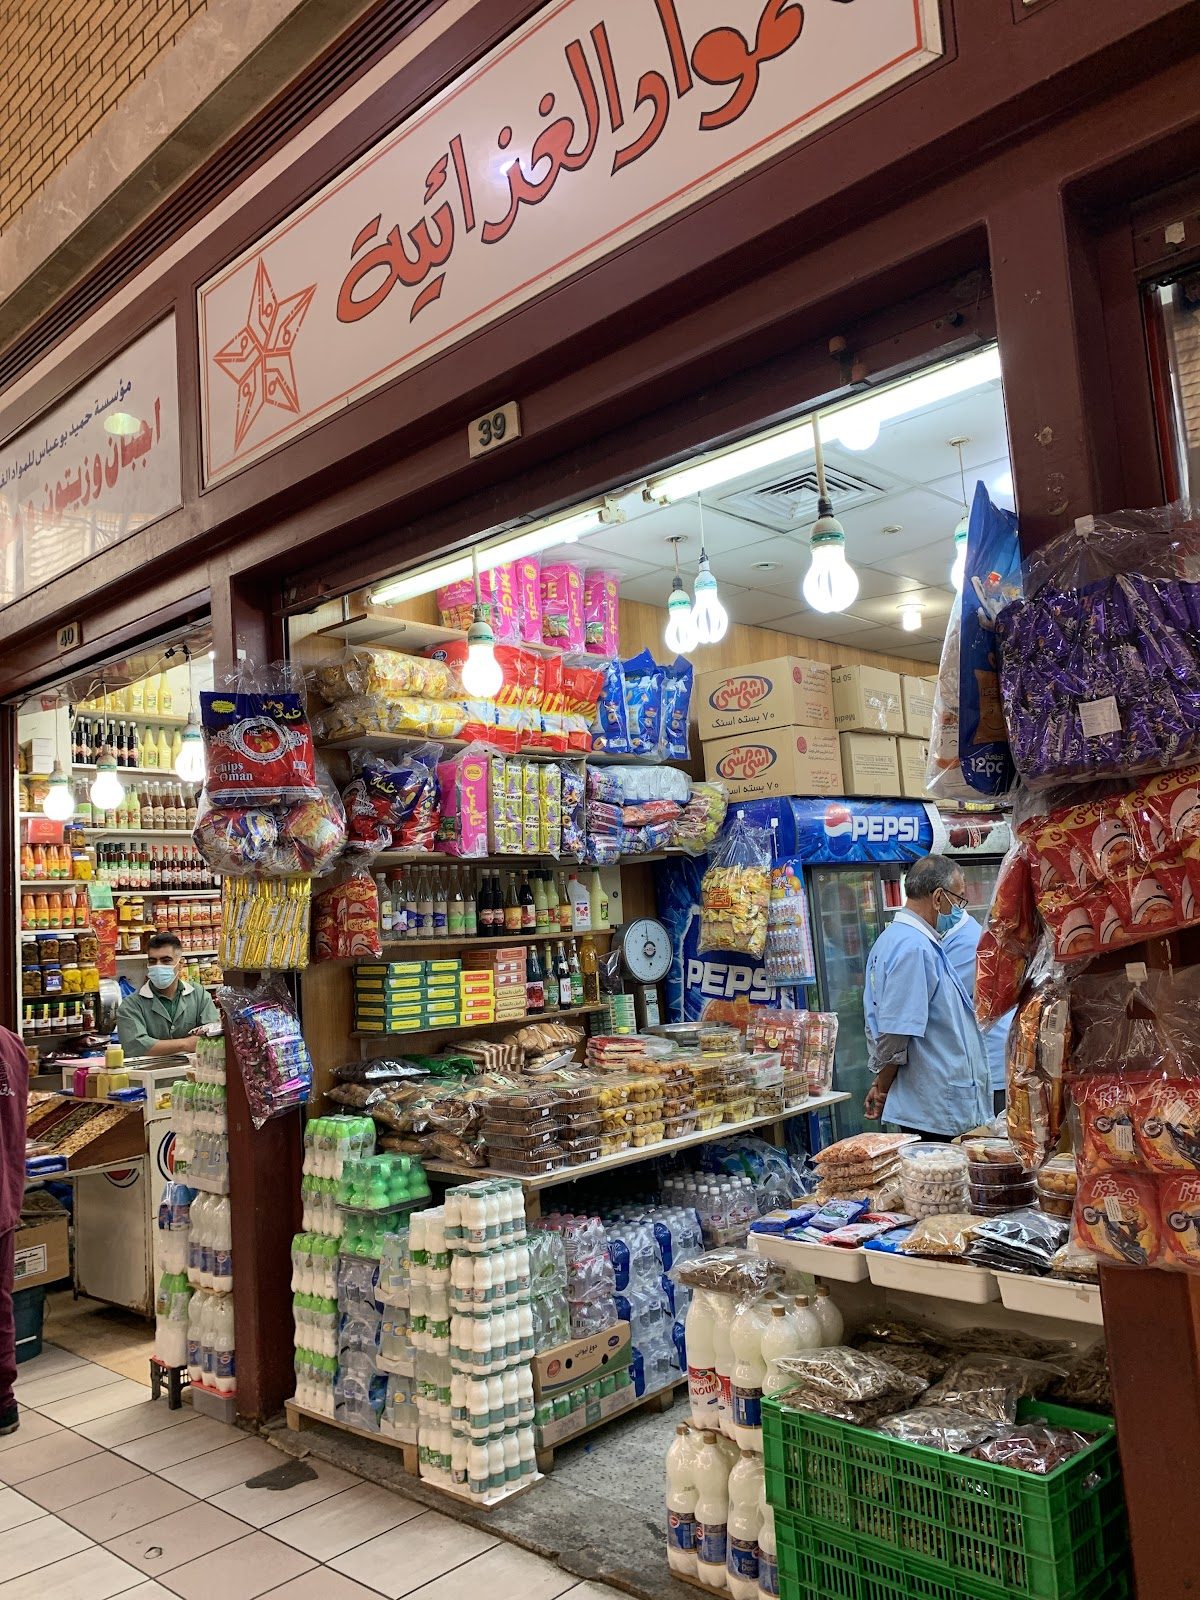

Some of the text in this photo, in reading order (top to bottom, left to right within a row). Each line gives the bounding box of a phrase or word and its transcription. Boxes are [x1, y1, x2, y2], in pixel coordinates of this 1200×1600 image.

[94, 378, 132, 416] مؤسسة
[478, 412, 506, 447] 39
[60, 626, 74, 647] 40
[213, 761, 244, 775] Chips
[220, 771, 253, 783] Oman
[970, 757, 1004, 777] 12pc
[851, 816, 919, 842] PEPSI
